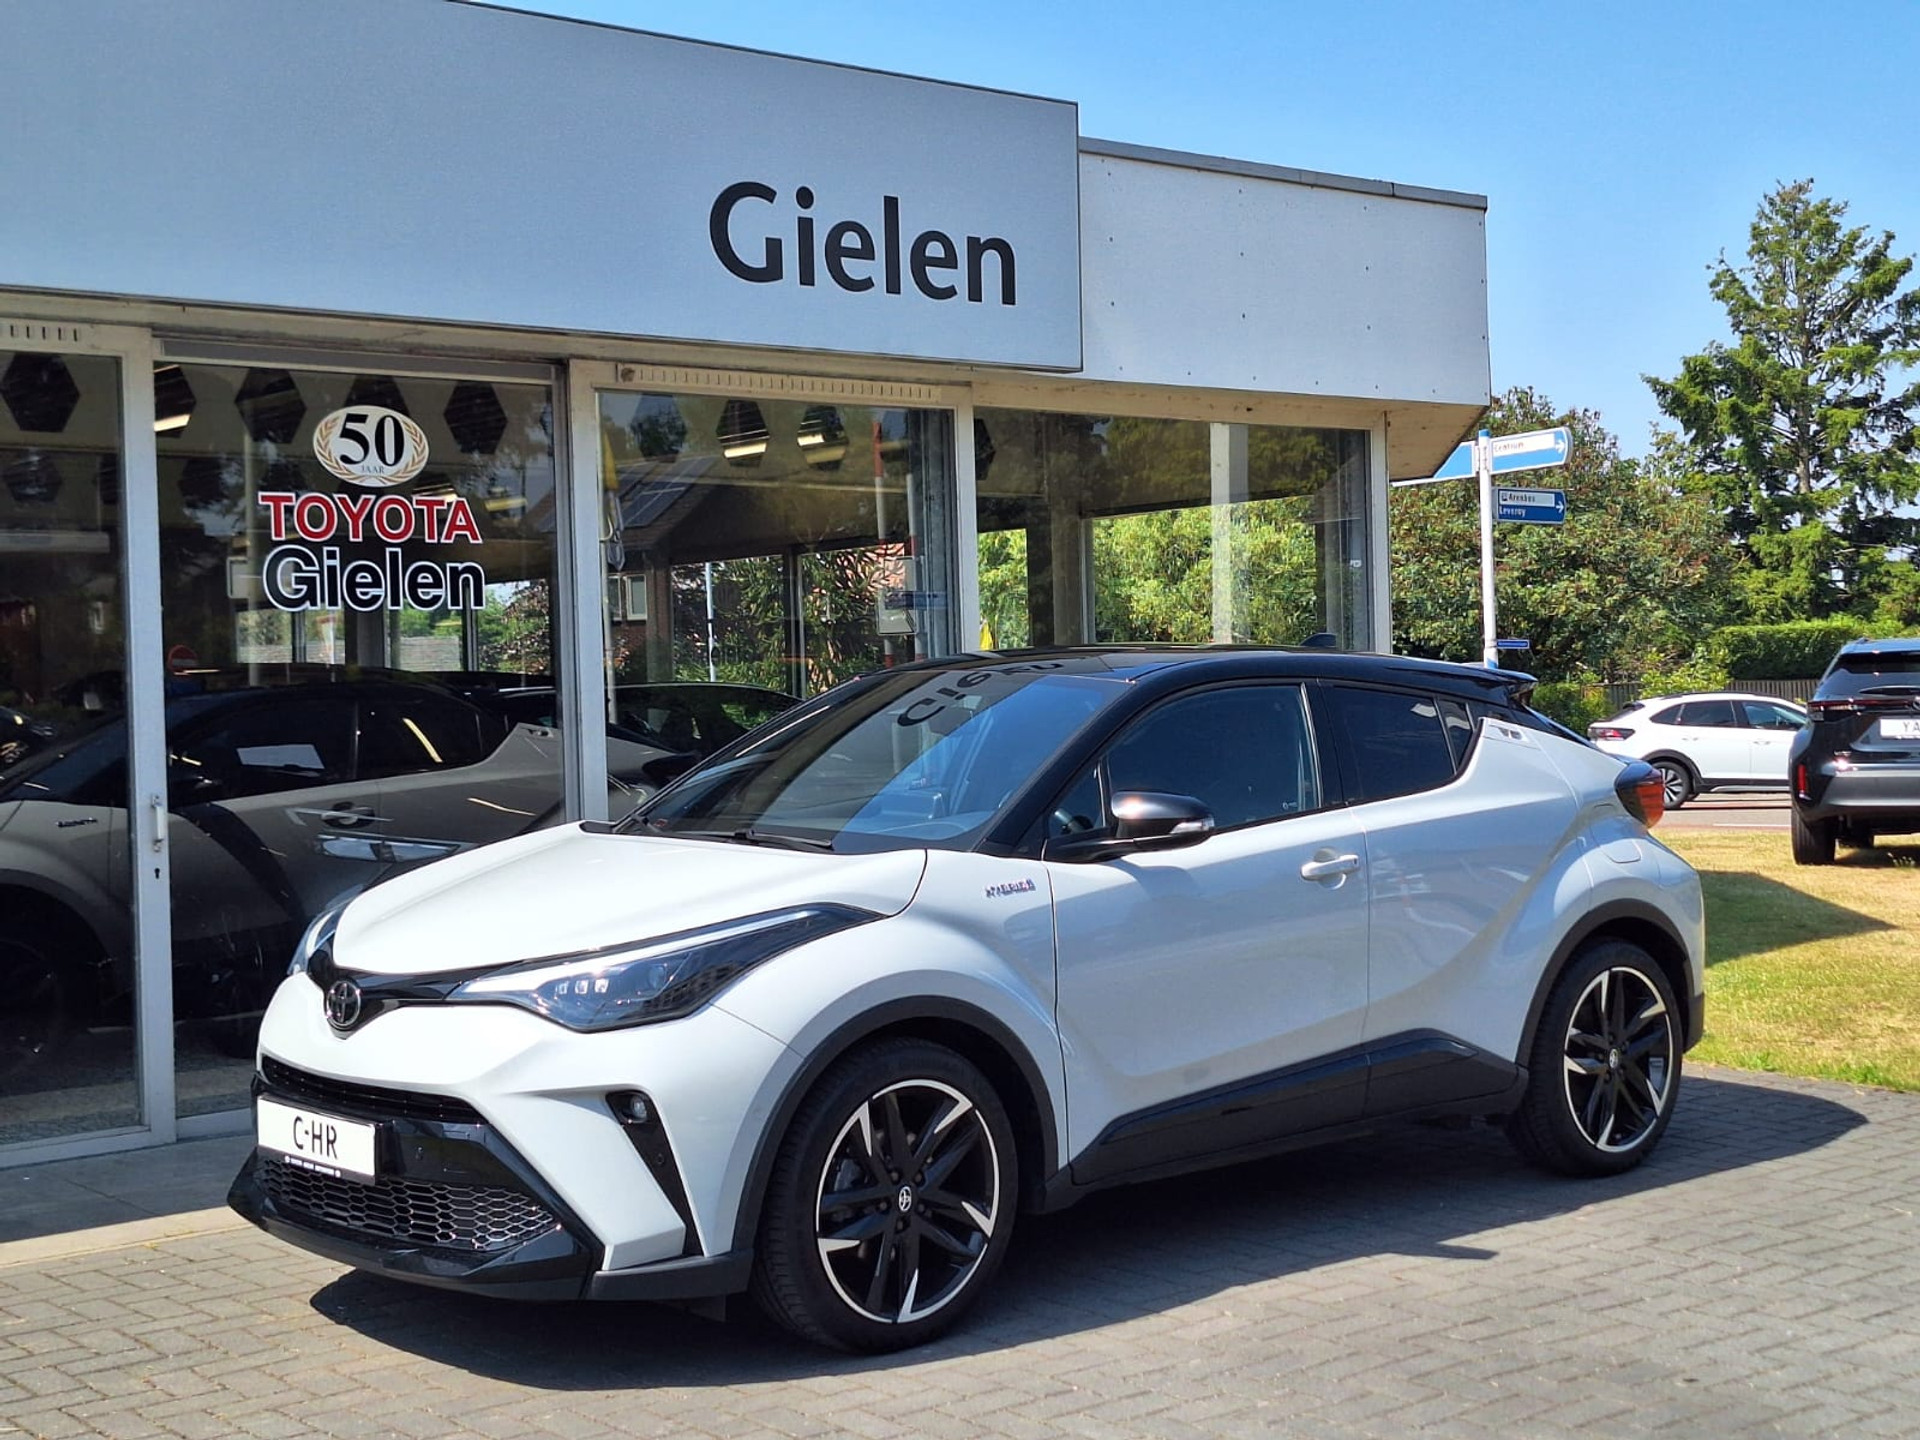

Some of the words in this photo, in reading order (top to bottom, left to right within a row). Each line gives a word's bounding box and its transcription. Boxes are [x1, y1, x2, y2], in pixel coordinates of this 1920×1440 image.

[709, 181, 1017, 306] Gielen
[339, 413, 405, 467] 50
[361, 465, 385, 474] JAAR
[258, 492, 483, 543] TOYOTA
[262, 544, 486, 612] Gielen
[293, 1115, 338, 1159] C-HR
